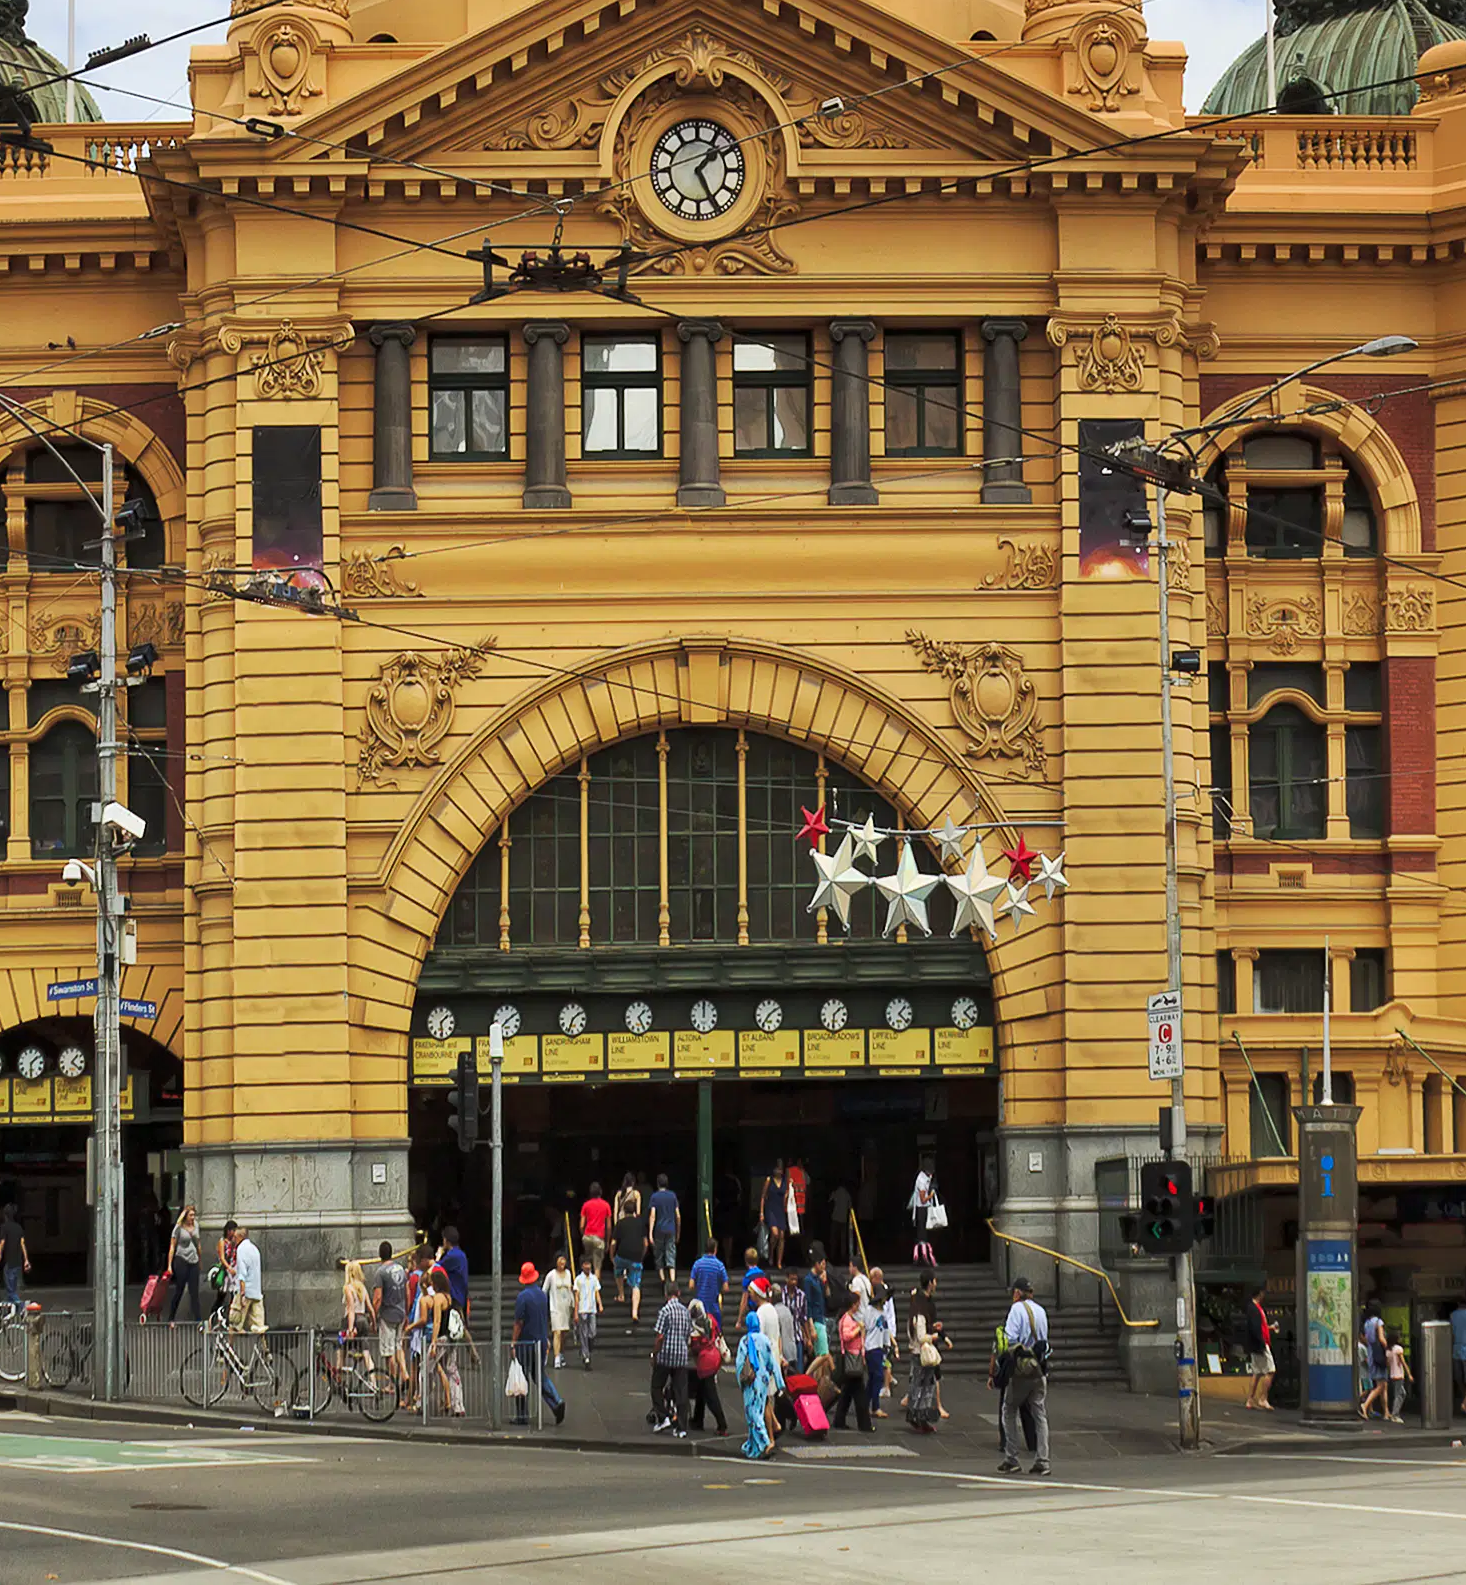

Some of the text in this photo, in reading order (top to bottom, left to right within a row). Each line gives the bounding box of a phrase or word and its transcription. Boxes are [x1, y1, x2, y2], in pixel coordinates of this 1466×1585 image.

[53, 981, 94, 996] Swanston St
[124, 1001, 156, 1014] Flinders St
[1149, 1014, 1179, 1024] CLEARWAY
[611, 1034, 660, 1044] WILLIAMSTOWN
[676, 1034, 703, 1043] ALTONA
[750, 1033, 776, 1042] ALBANS
[806, 1032, 861, 1042] BROADMEADOWS
[871, 1031, 899, 1040] UPFIELD
[544, 1037, 591, 1047] SANDRINGHAM
[806, 1042, 821, 1052] LINE
[871, 1041, 886, 1051] LINE
[937, 1040, 952, 1050] LINE
[544, 1047, 559, 1057] LINE
[611, 1045, 626, 1055] LINE
[676, 1044, 692, 1053] LINE
[741, 1043, 756, 1053] LINE
